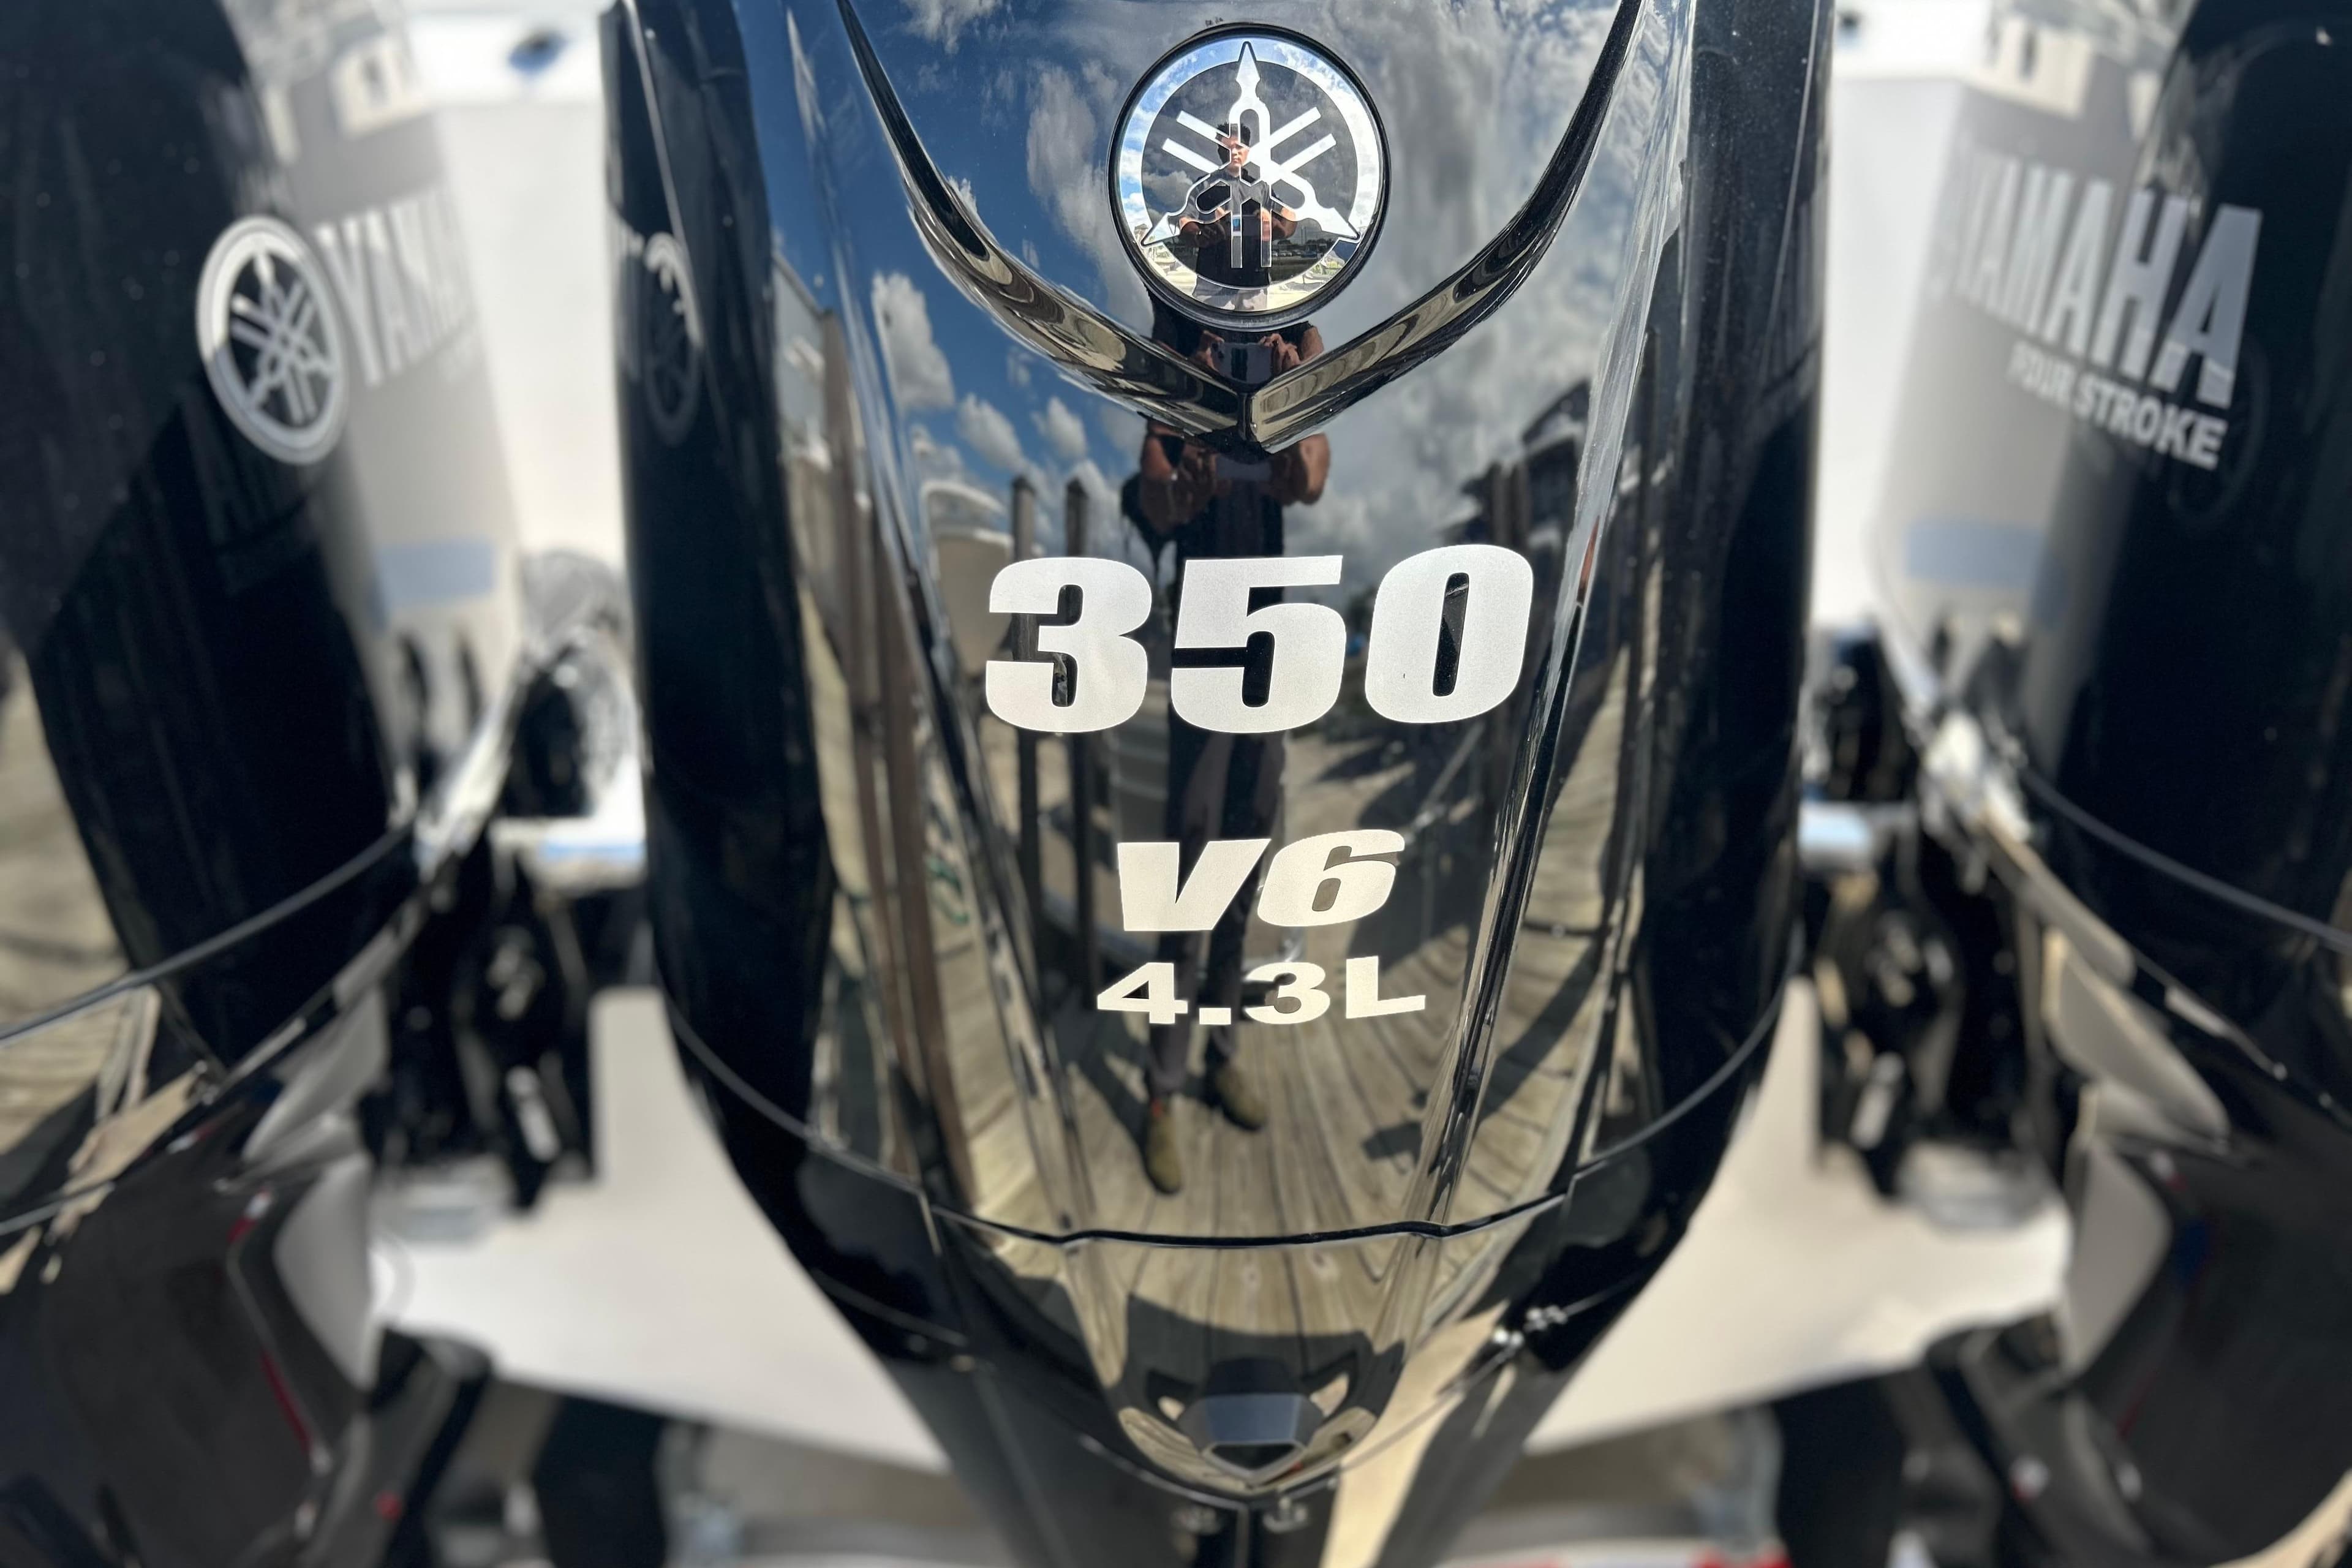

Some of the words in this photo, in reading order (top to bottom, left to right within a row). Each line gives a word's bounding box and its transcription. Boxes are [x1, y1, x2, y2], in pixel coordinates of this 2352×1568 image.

[2075, 372, 2228, 470] STROKE
[986, 544, 1534, 733] 350
[1117, 829, 1405, 932] V6
[1097, 956, 1426, 1025] 4.3L
